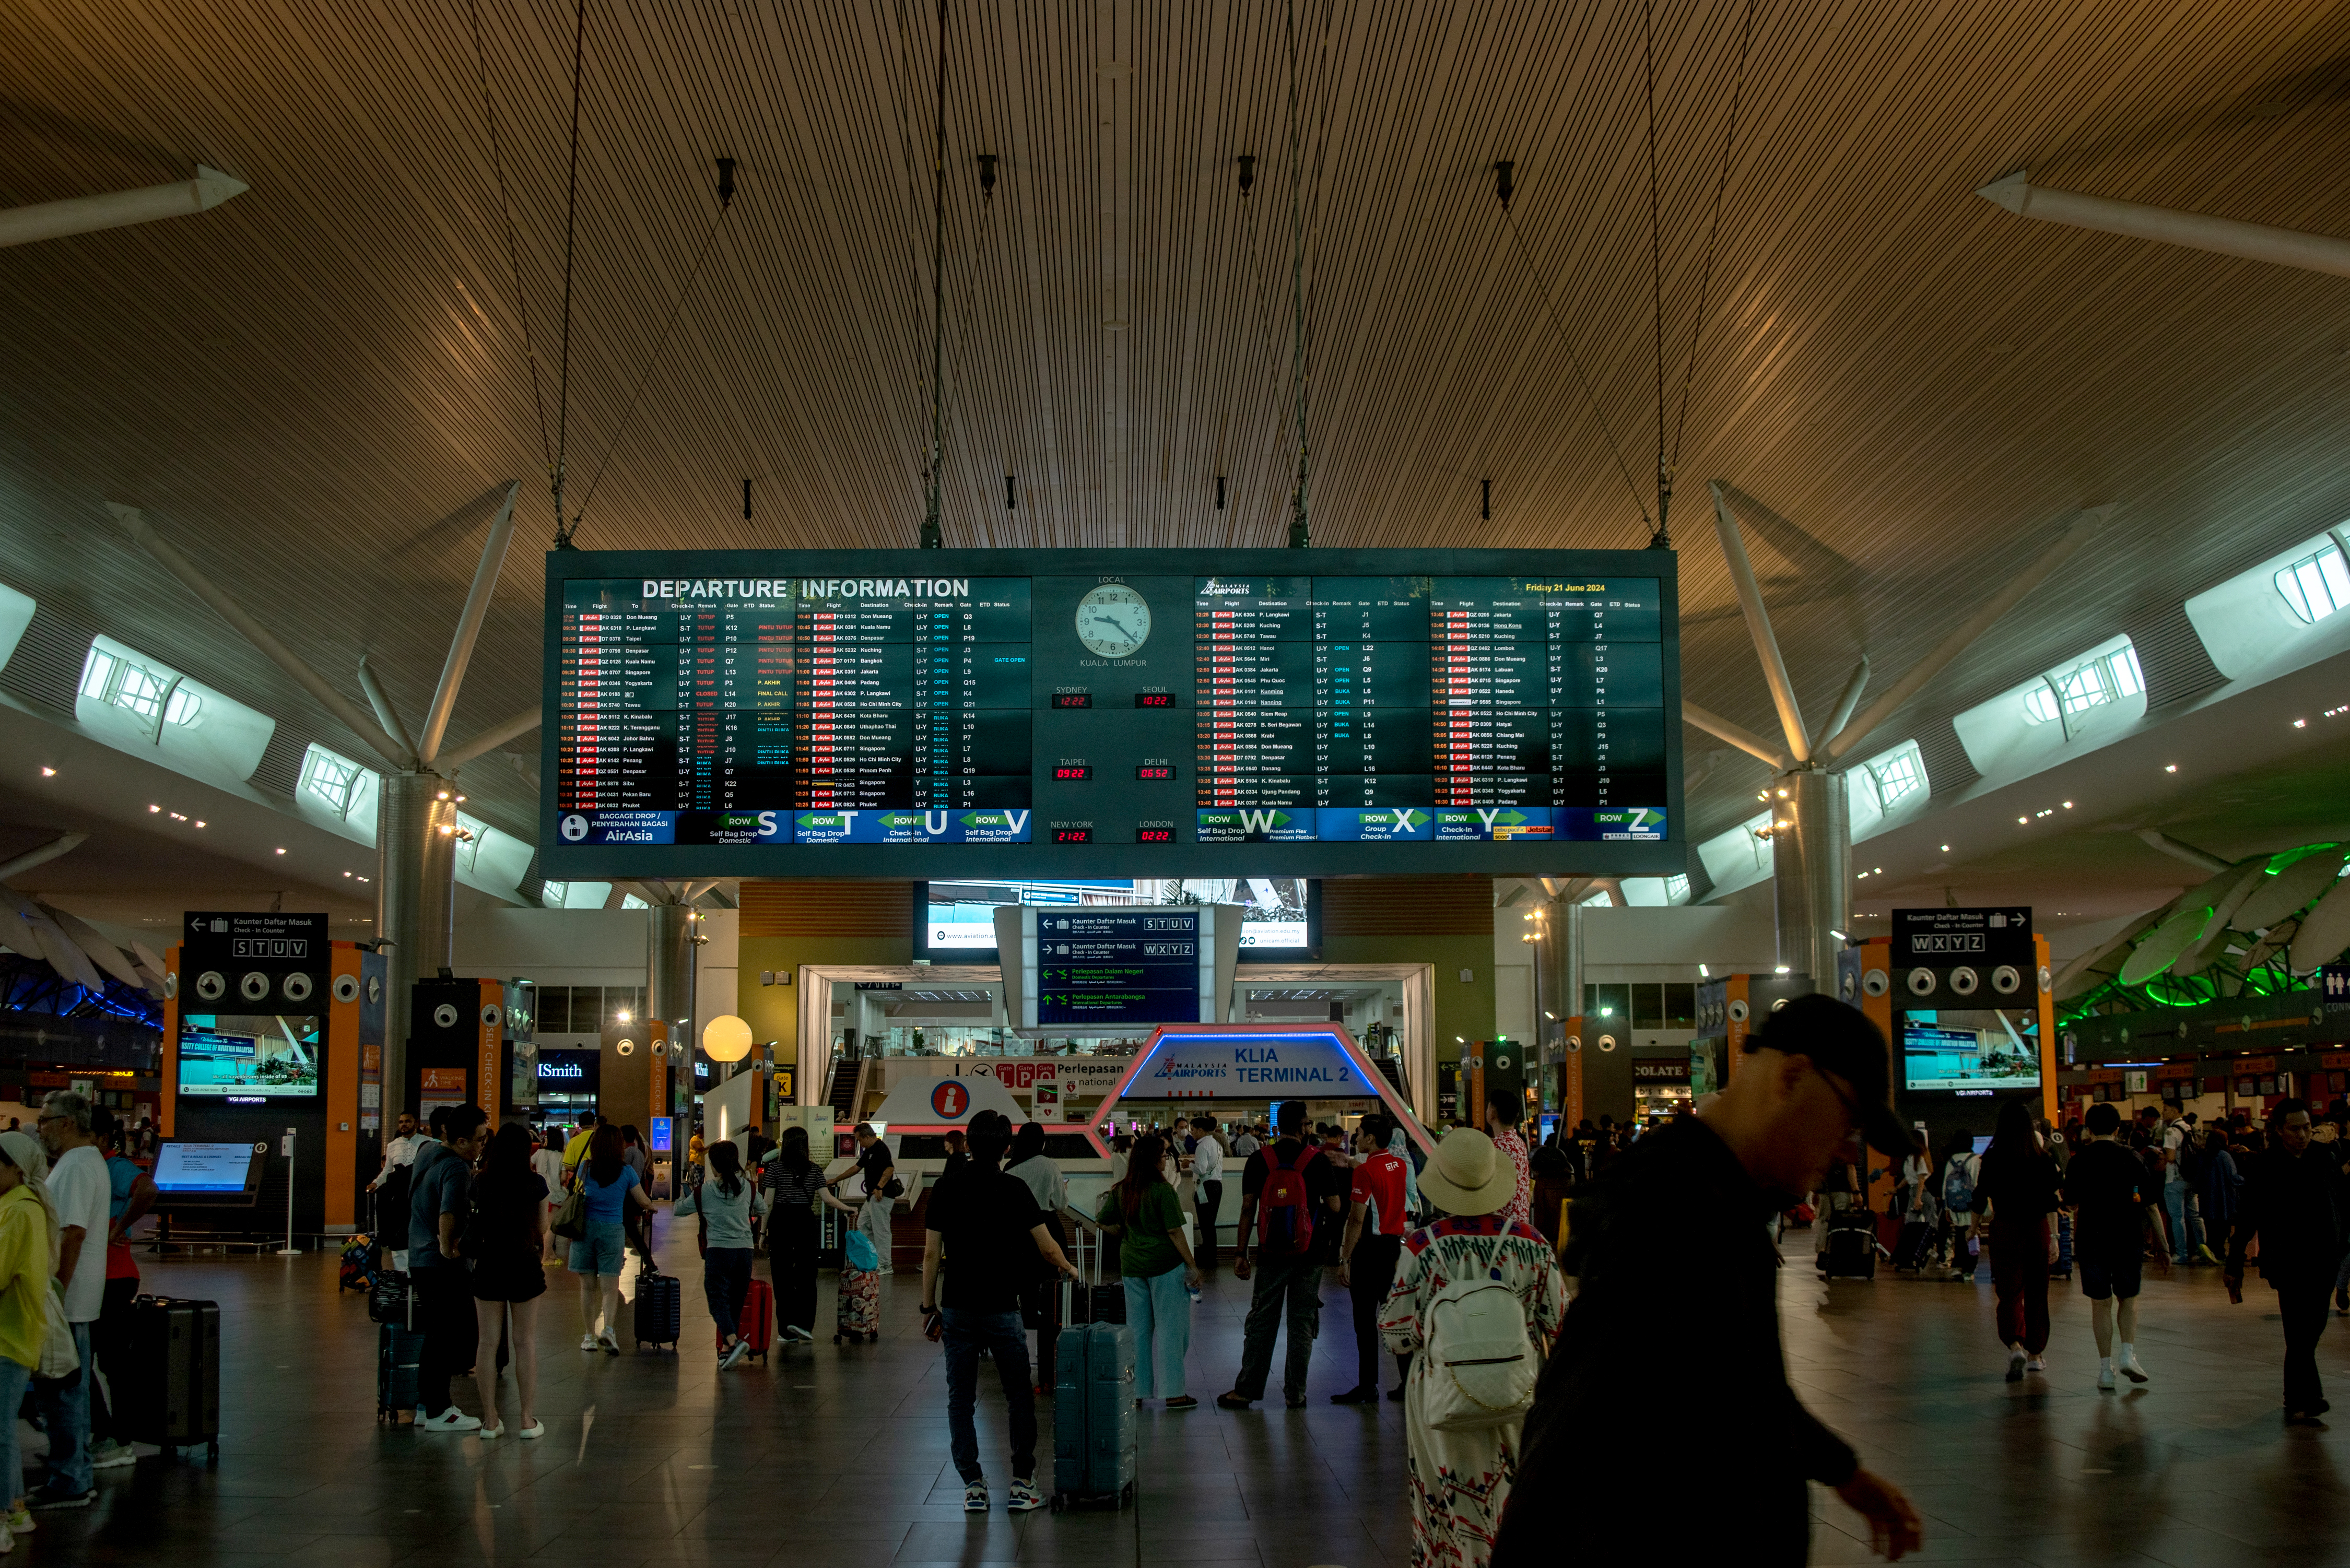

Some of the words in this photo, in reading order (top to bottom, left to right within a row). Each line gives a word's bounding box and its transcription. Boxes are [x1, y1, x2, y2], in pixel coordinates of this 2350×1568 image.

[643, 580, 787, 598] DEPARTURE
[802, 579, 968, 597] INFORMATION
[1526, 584, 1552, 592] Friday
[757, 811, 777, 835] S
[838, 811, 858, 835] T
[925, 810, 947, 835] U
[1003, 810, 1029, 834] V
[1239, 809, 1276, 834] W
[1392, 809, 1415, 833] X
[1477, 808, 1499, 832] Y
[1628, 808, 1649, 832] Z
[605, 830, 653, 841] AirAsia
[194, 1043, 212, 1051] COLLEGE
[1236, 1048, 1278, 1063] KLIA
[484, 1053, 492, 1101] CHECK-IN
[1058, 1064, 1123, 1075] Perlepasan
[1173, 1069, 1226, 1078] AIRPORTS
[1236, 1067, 1333, 1082] TERMINAL
[1339, 1067, 1348, 1081] 2
[1001, 1072, 1009, 1086] L
[1021, 1071, 1030, 1086] P
[779, 1082, 786, 1092] K
[1385, 1161, 1399, 1170] GTR
